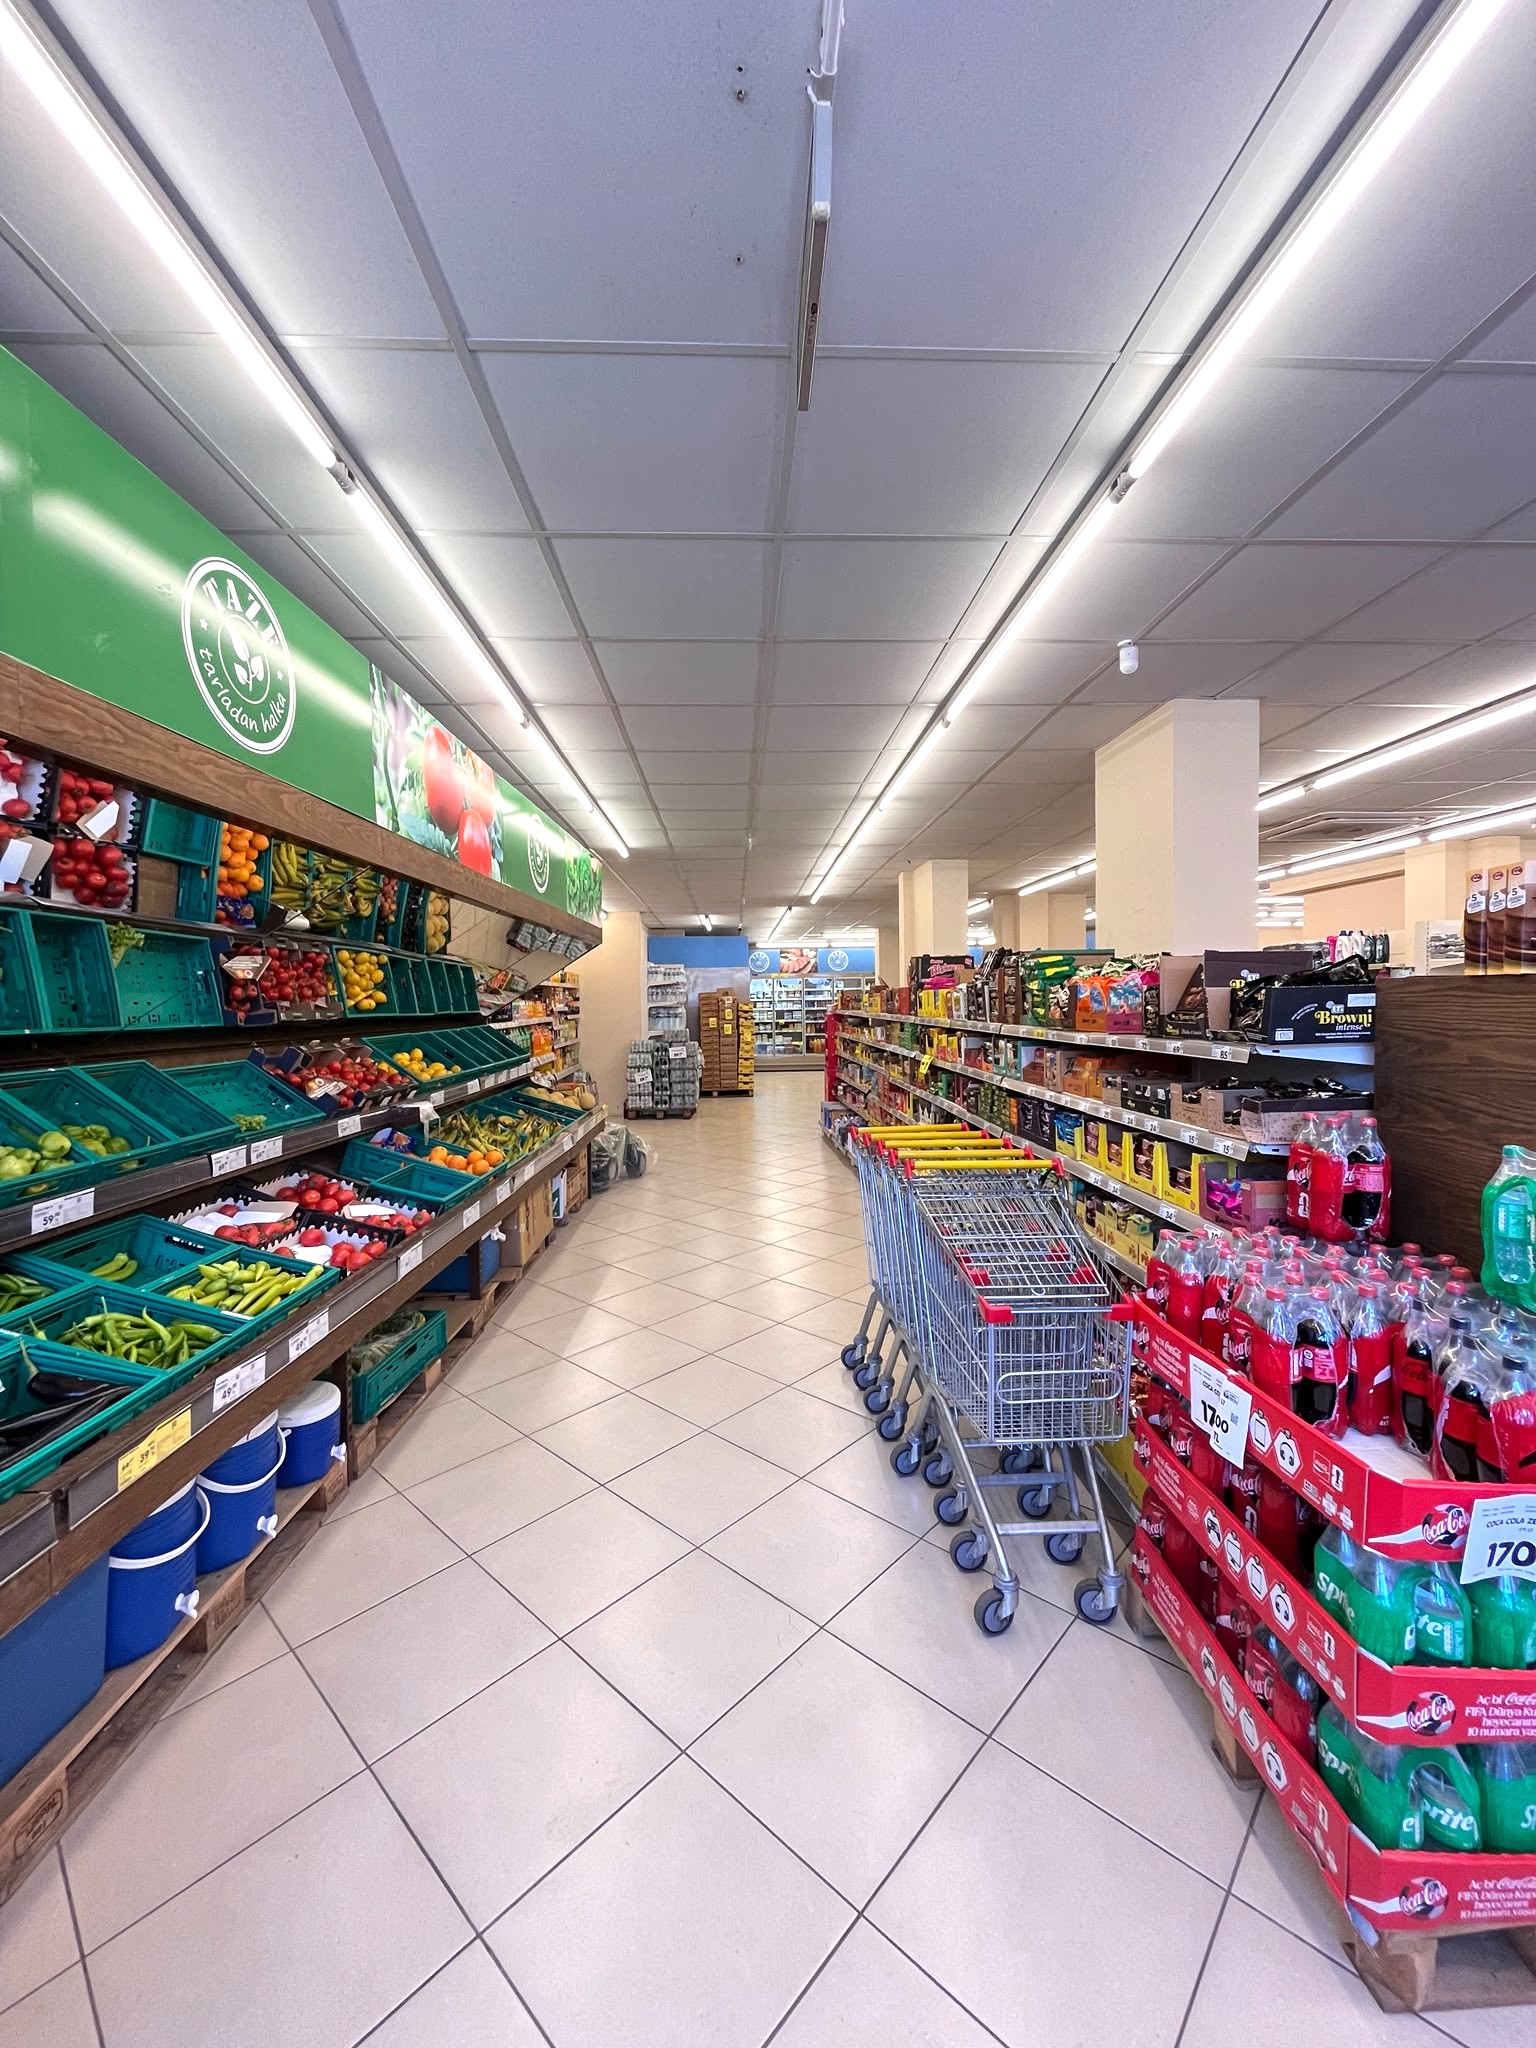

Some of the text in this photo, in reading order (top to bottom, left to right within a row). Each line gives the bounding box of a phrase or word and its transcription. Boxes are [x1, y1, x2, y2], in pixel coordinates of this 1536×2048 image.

[200, 647, 286, 733] tarladan halka
[1314, 1008, 1372, 1027] Browni
[1335, 1023, 1364, 1031] intense
[1219, 1050, 1228, 1060] 85
[1223, 1144, 1230, 1154] 15
[43, 1214, 54, 1226] 59
[1486, 1517, 1536, 1528] COCA COLA ZE
[1465, 1706, 1487, 1717] FIFA
